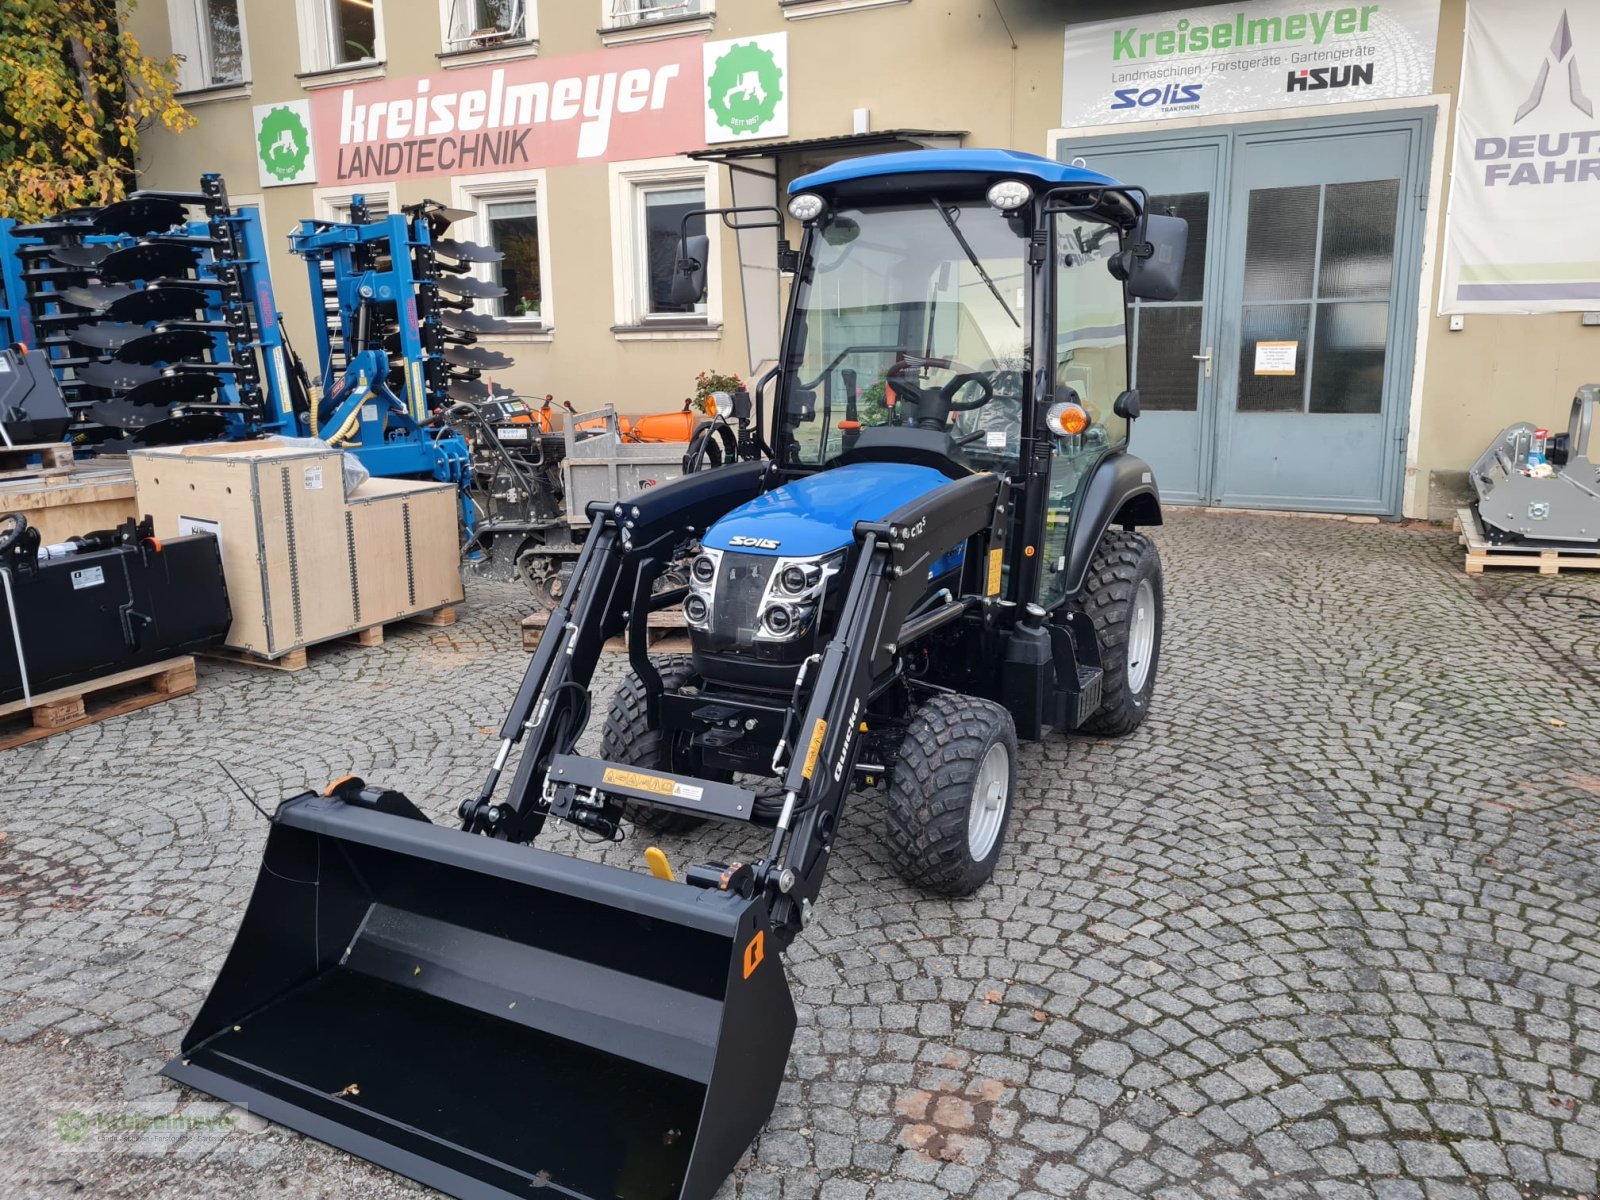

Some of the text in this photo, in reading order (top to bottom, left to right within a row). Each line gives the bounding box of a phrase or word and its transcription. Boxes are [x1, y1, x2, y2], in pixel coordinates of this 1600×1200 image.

[1113, 5, 1379, 61] Kreiselmeyer
[1112, 46, 1376, 84] Landmaschinen Forstgeräte Gartengeräte
[339, 64, 680, 158] kreiselmeyer
[1161, 104, 1200, 113] TRAKTOREN
[337, 128, 533, 180] LANDTECHNIK
[1474, 130, 1600, 160] DEUT
[1484, 158, 1600, 187] FAHR
[834, 697, 860, 782] Quicke
